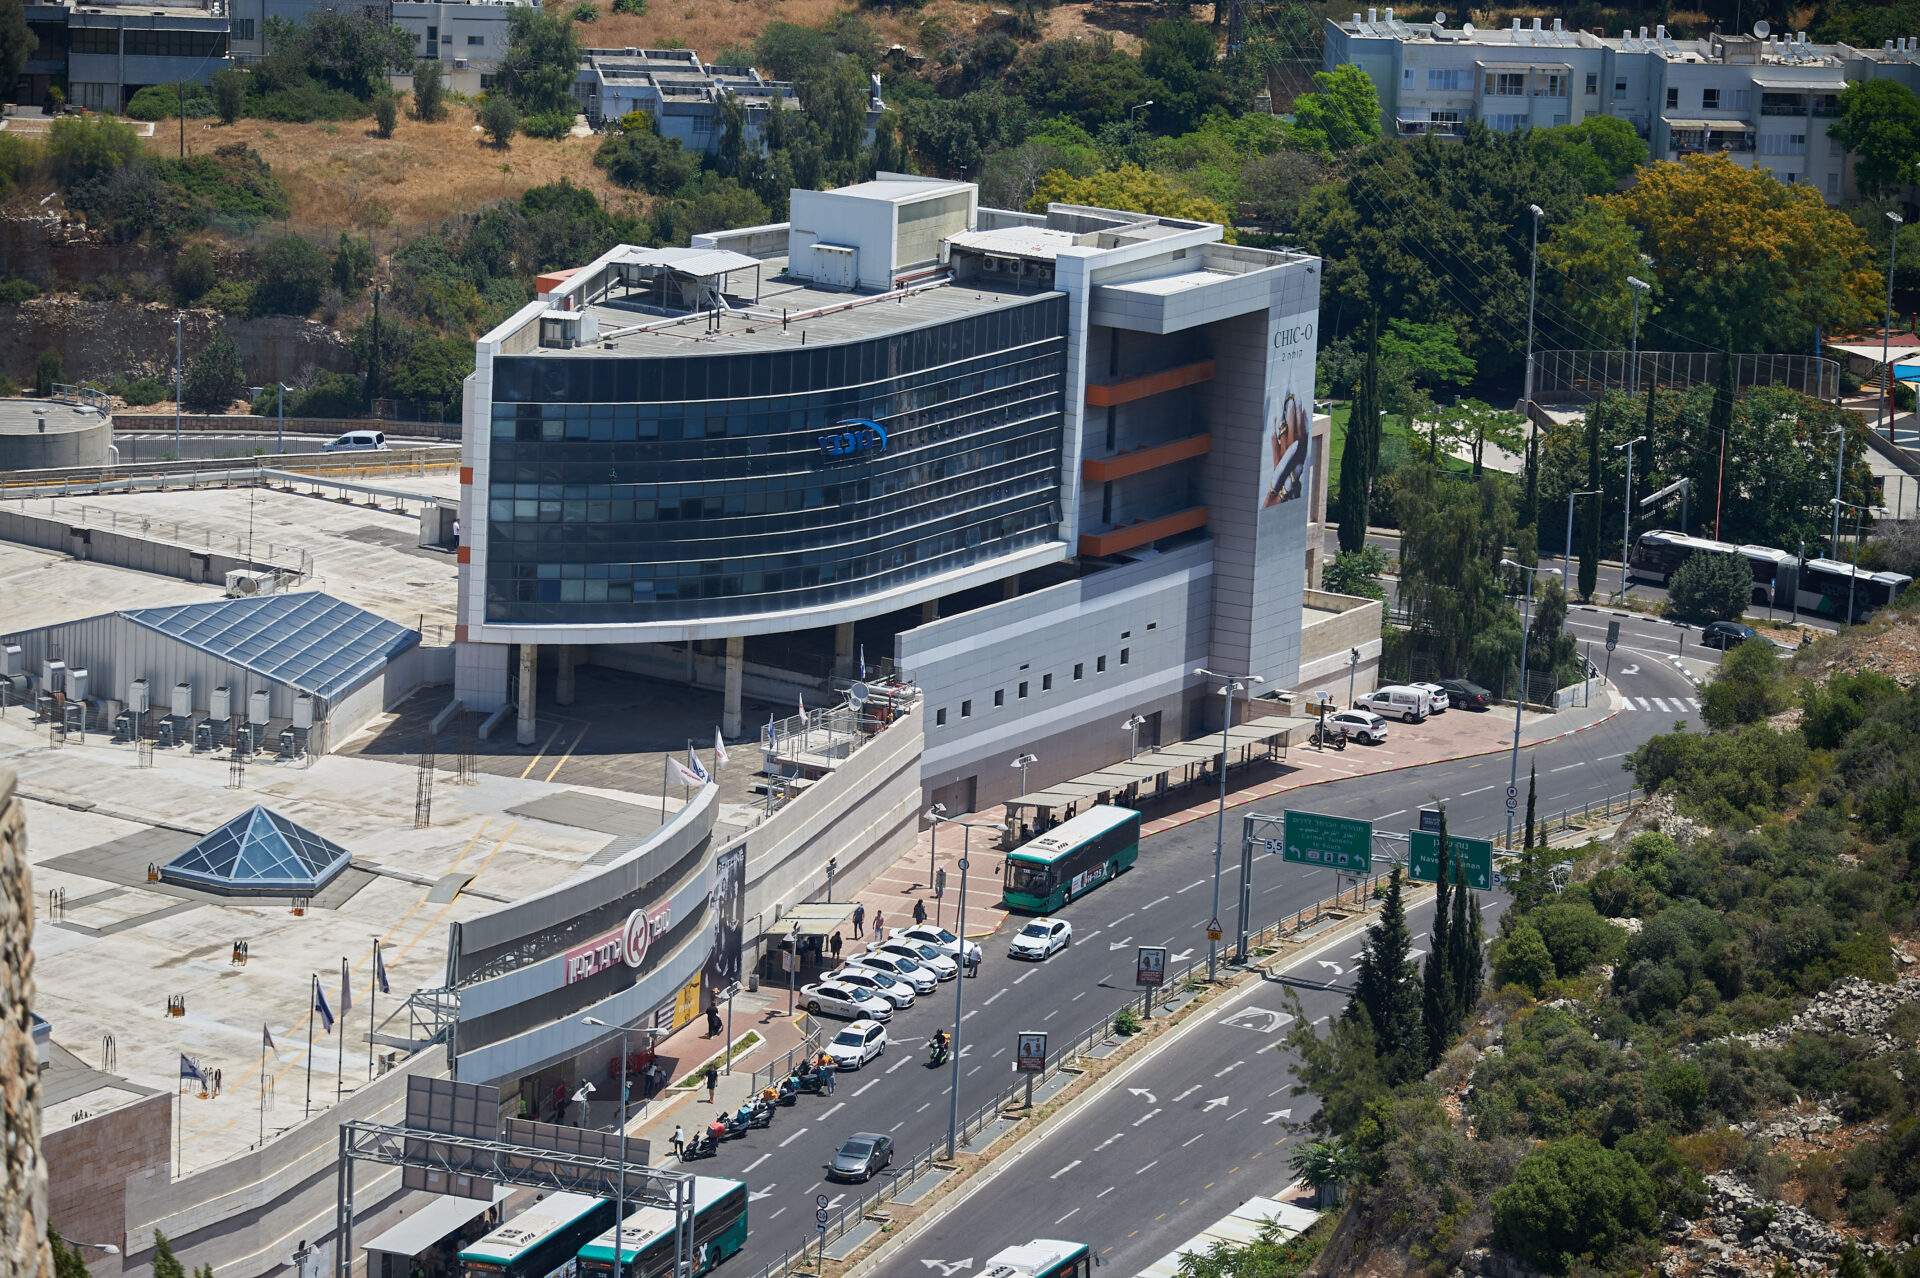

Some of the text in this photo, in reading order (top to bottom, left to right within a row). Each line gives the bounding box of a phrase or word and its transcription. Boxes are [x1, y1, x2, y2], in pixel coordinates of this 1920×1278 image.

[1274, 323, 1312, 348] CHIC-O
[818, 429, 873, 455] מכבי
[1292, 817, 1364, 832] מנהרות הכרמל לדרום
[1301, 833, 1353, 846] Carmel Tunnels
[1323, 842, 1342, 850] South
[1420, 855, 1440, 864] Nave
[568, 909, 670, 984] עופר גרנד קניון
